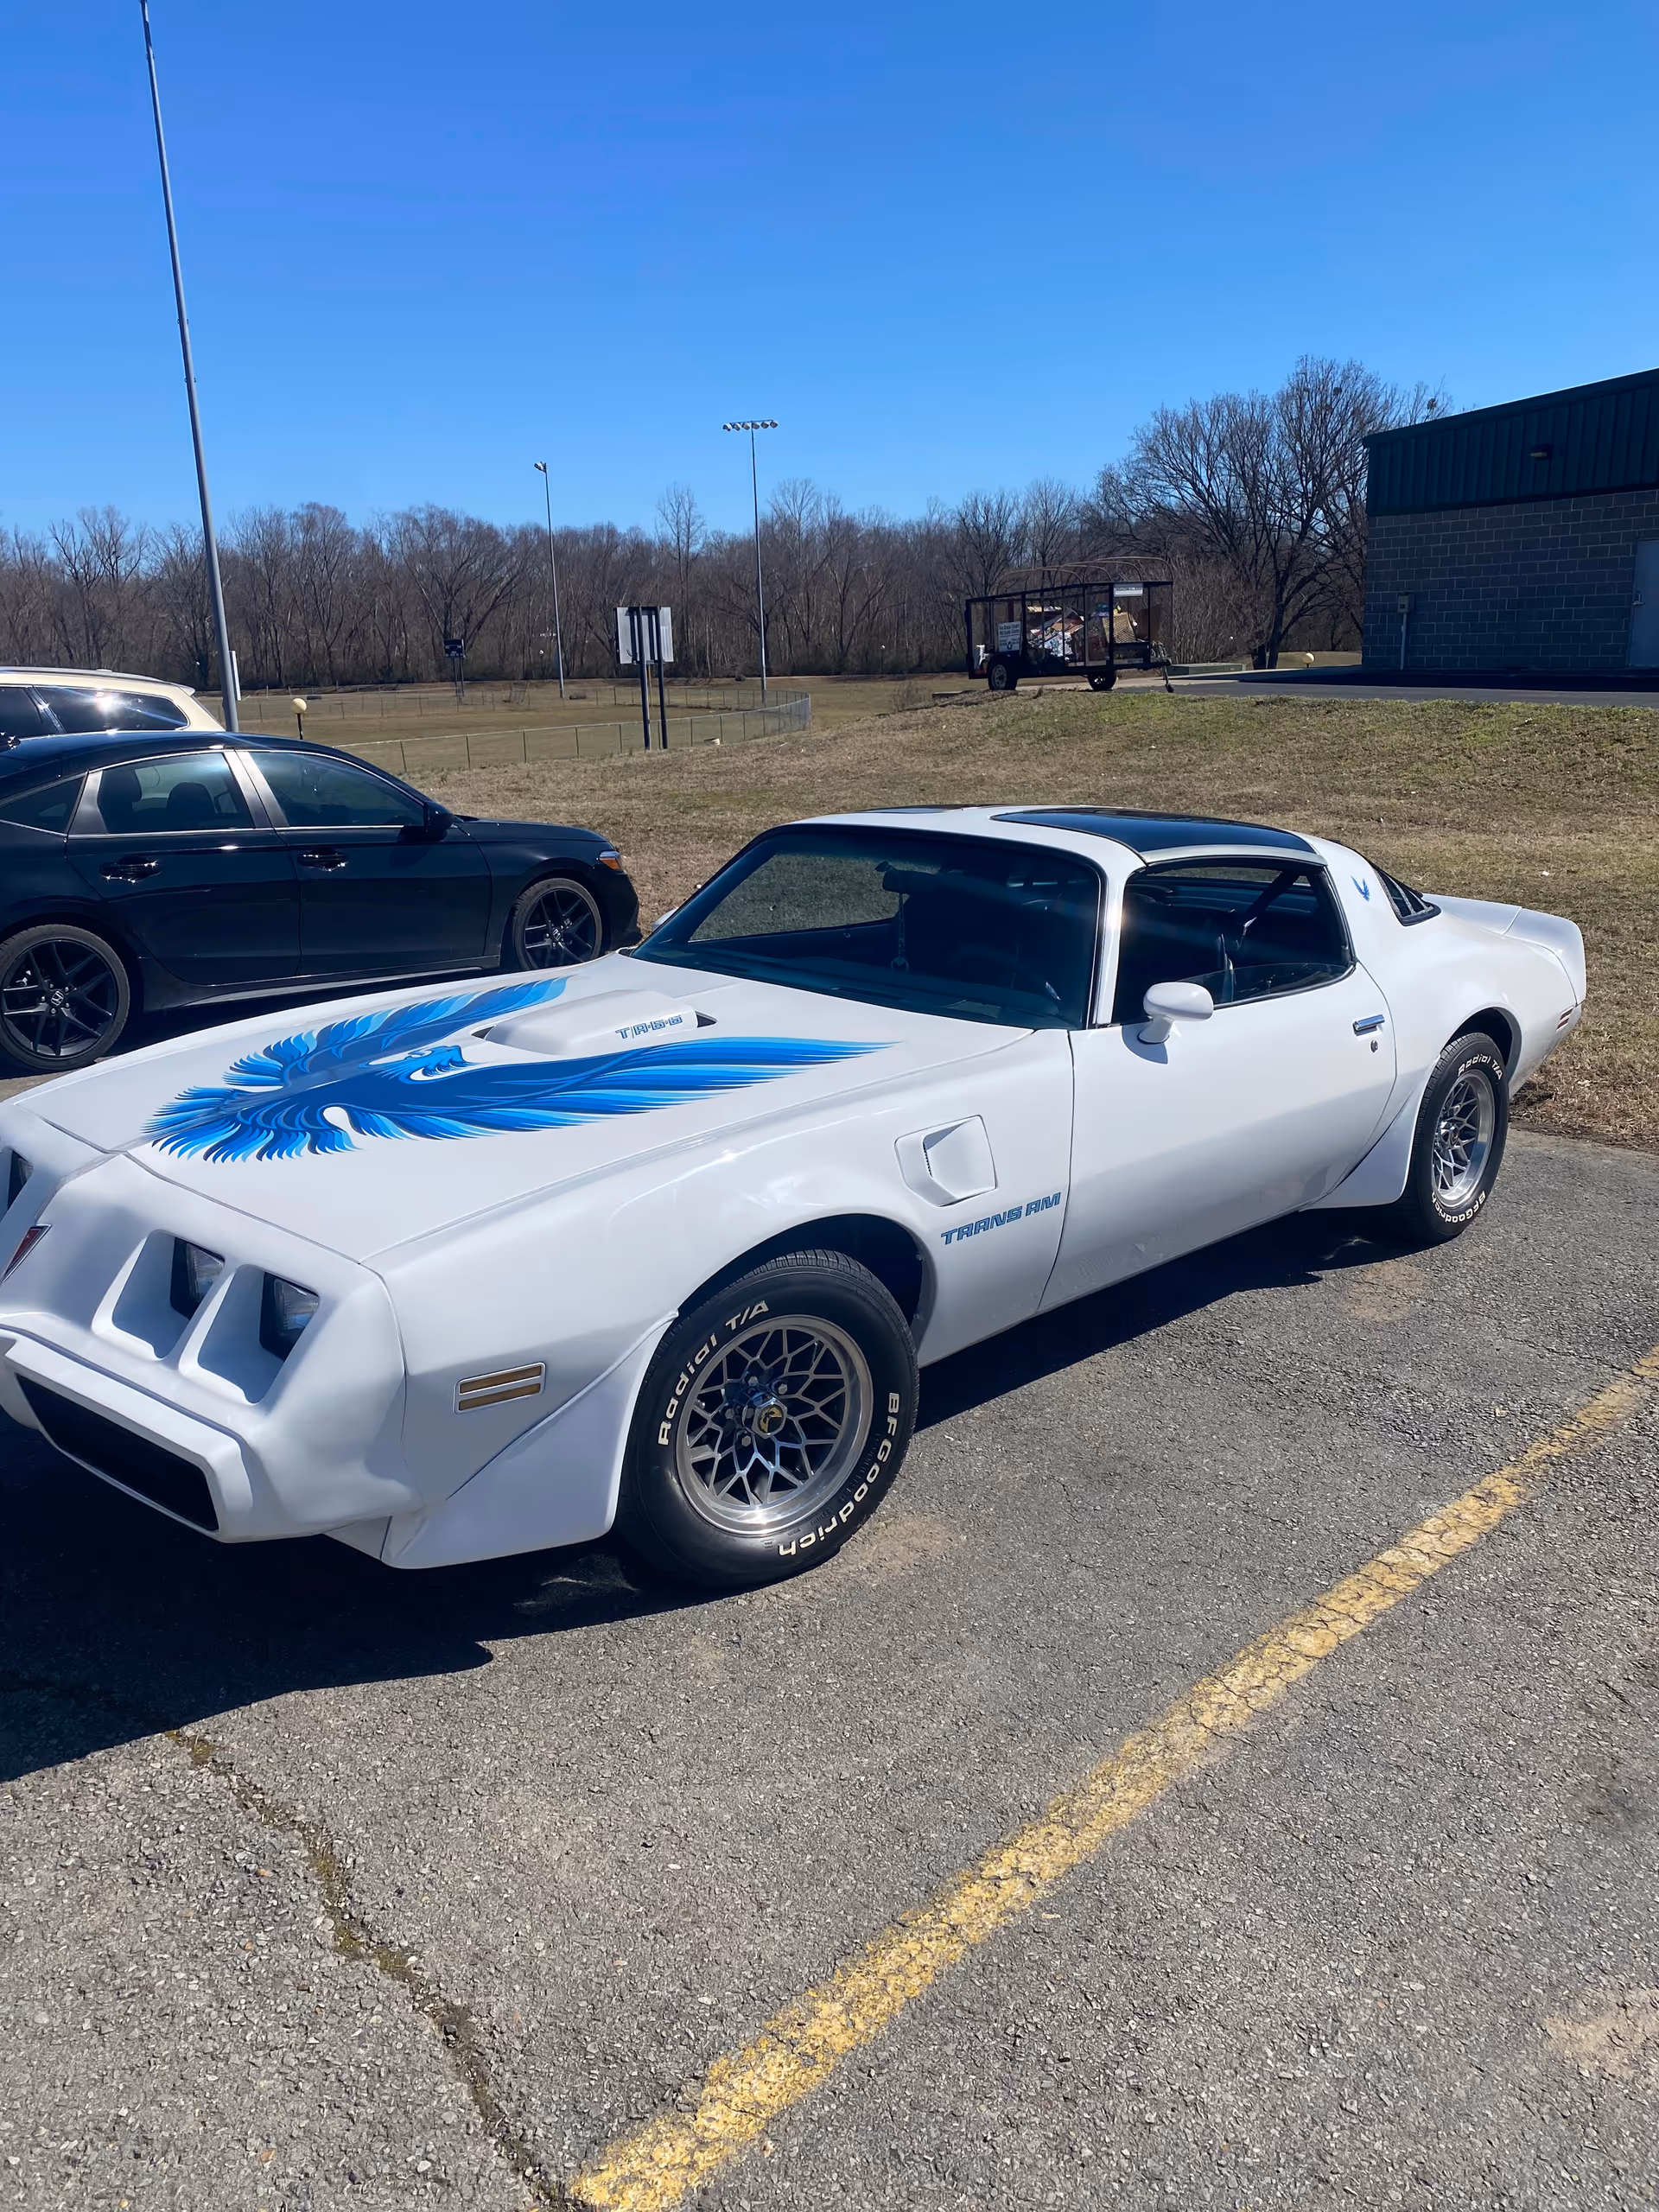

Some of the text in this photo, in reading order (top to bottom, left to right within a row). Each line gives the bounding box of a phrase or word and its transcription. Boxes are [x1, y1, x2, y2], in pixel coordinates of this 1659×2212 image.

[1458, 1053, 1503, 1080] Radial T/A
[941, 1192, 1061, 1245] TRANS AM
[658, 1300, 769, 1446] Radial T/A
